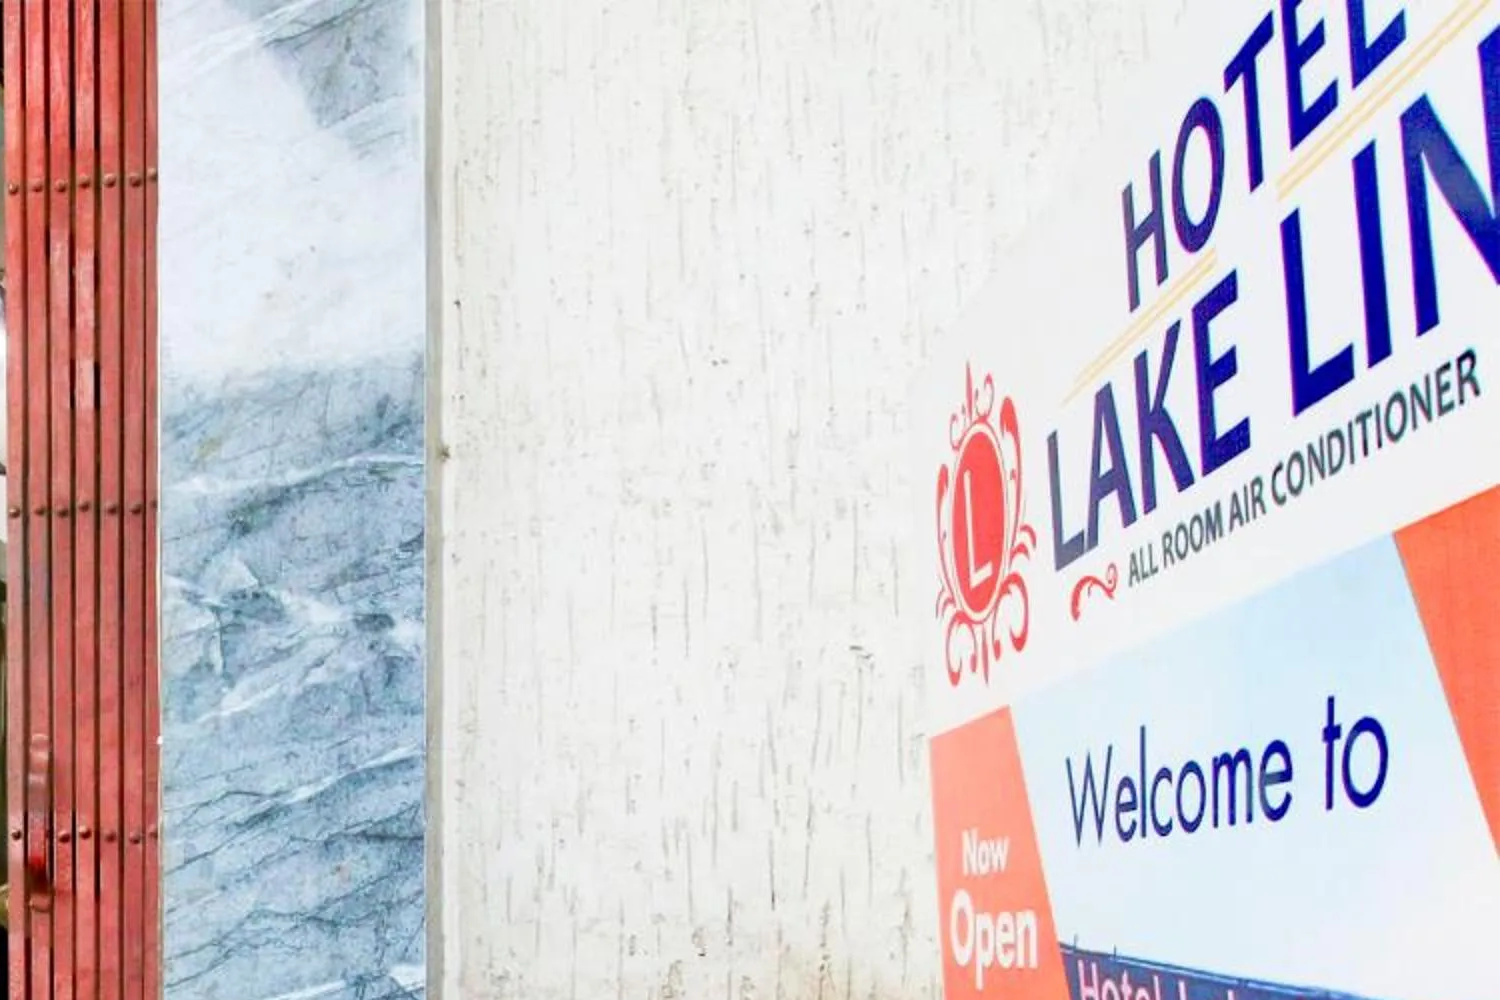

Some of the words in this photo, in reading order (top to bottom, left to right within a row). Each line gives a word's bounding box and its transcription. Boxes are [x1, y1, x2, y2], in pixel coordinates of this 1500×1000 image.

[1121, 0, 1407, 314] HOTEL
[1047, 268, 1251, 571] LAKE
[1128, 543, 1159, 587] ALL
[1162, 502, 1223, 569] ROOM
[1228, 476, 1267, 533] AIR
[1271, 347, 1482, 506] CONDITIONER
[962, 828, 1009, 877] Now
[1065, 725, 1294, 849] Welcome
[1322, 695, 1389, 811] to
[950, 889, 1039, 990] Open
